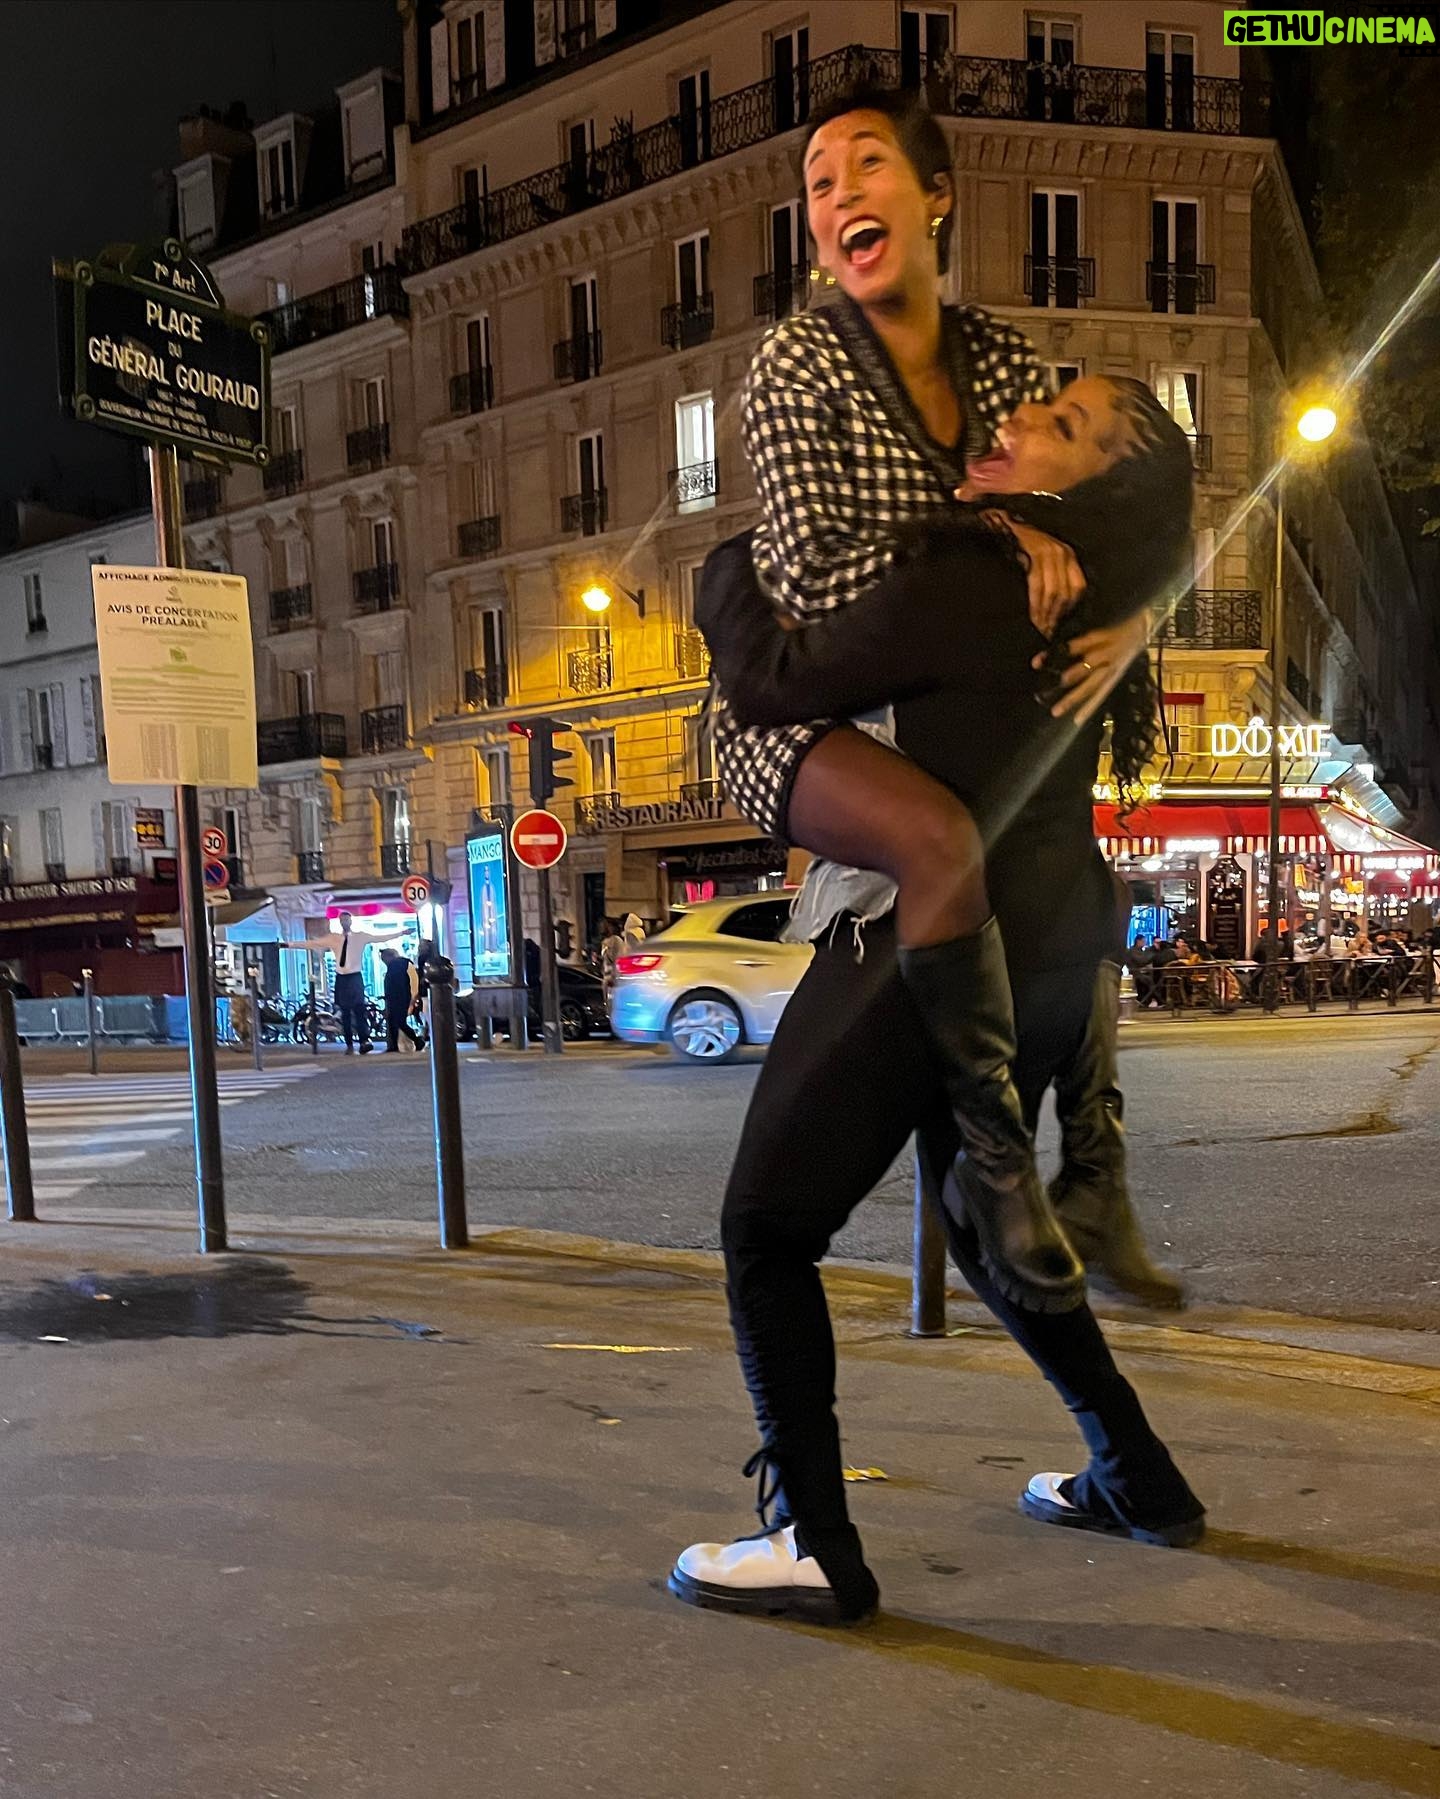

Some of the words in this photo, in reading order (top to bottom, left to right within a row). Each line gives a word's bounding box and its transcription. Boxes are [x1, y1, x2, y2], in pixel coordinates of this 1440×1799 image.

[146, 299, 203, 344] PLACE
[167, 341, 182, 358] DU
[88, 334, 171, 386] GÉNÉRAL
[175, 363, 259, 411] GOURAUD
[98, 571, 150, 582] AFFICHAGE
[107, 604, 133, 614] AVIS
[136, 605, 151, 615] DE
[155, 606, 240, 622] CONCERTATION
[1211, 716, 1332, 757] DÔME
[592, 796, 723, 830] RESTAURANT
[206, 836, 221, 849] 30
[469, 840, 502, 862] MANGO
[408, 886, 427, 900] 30
